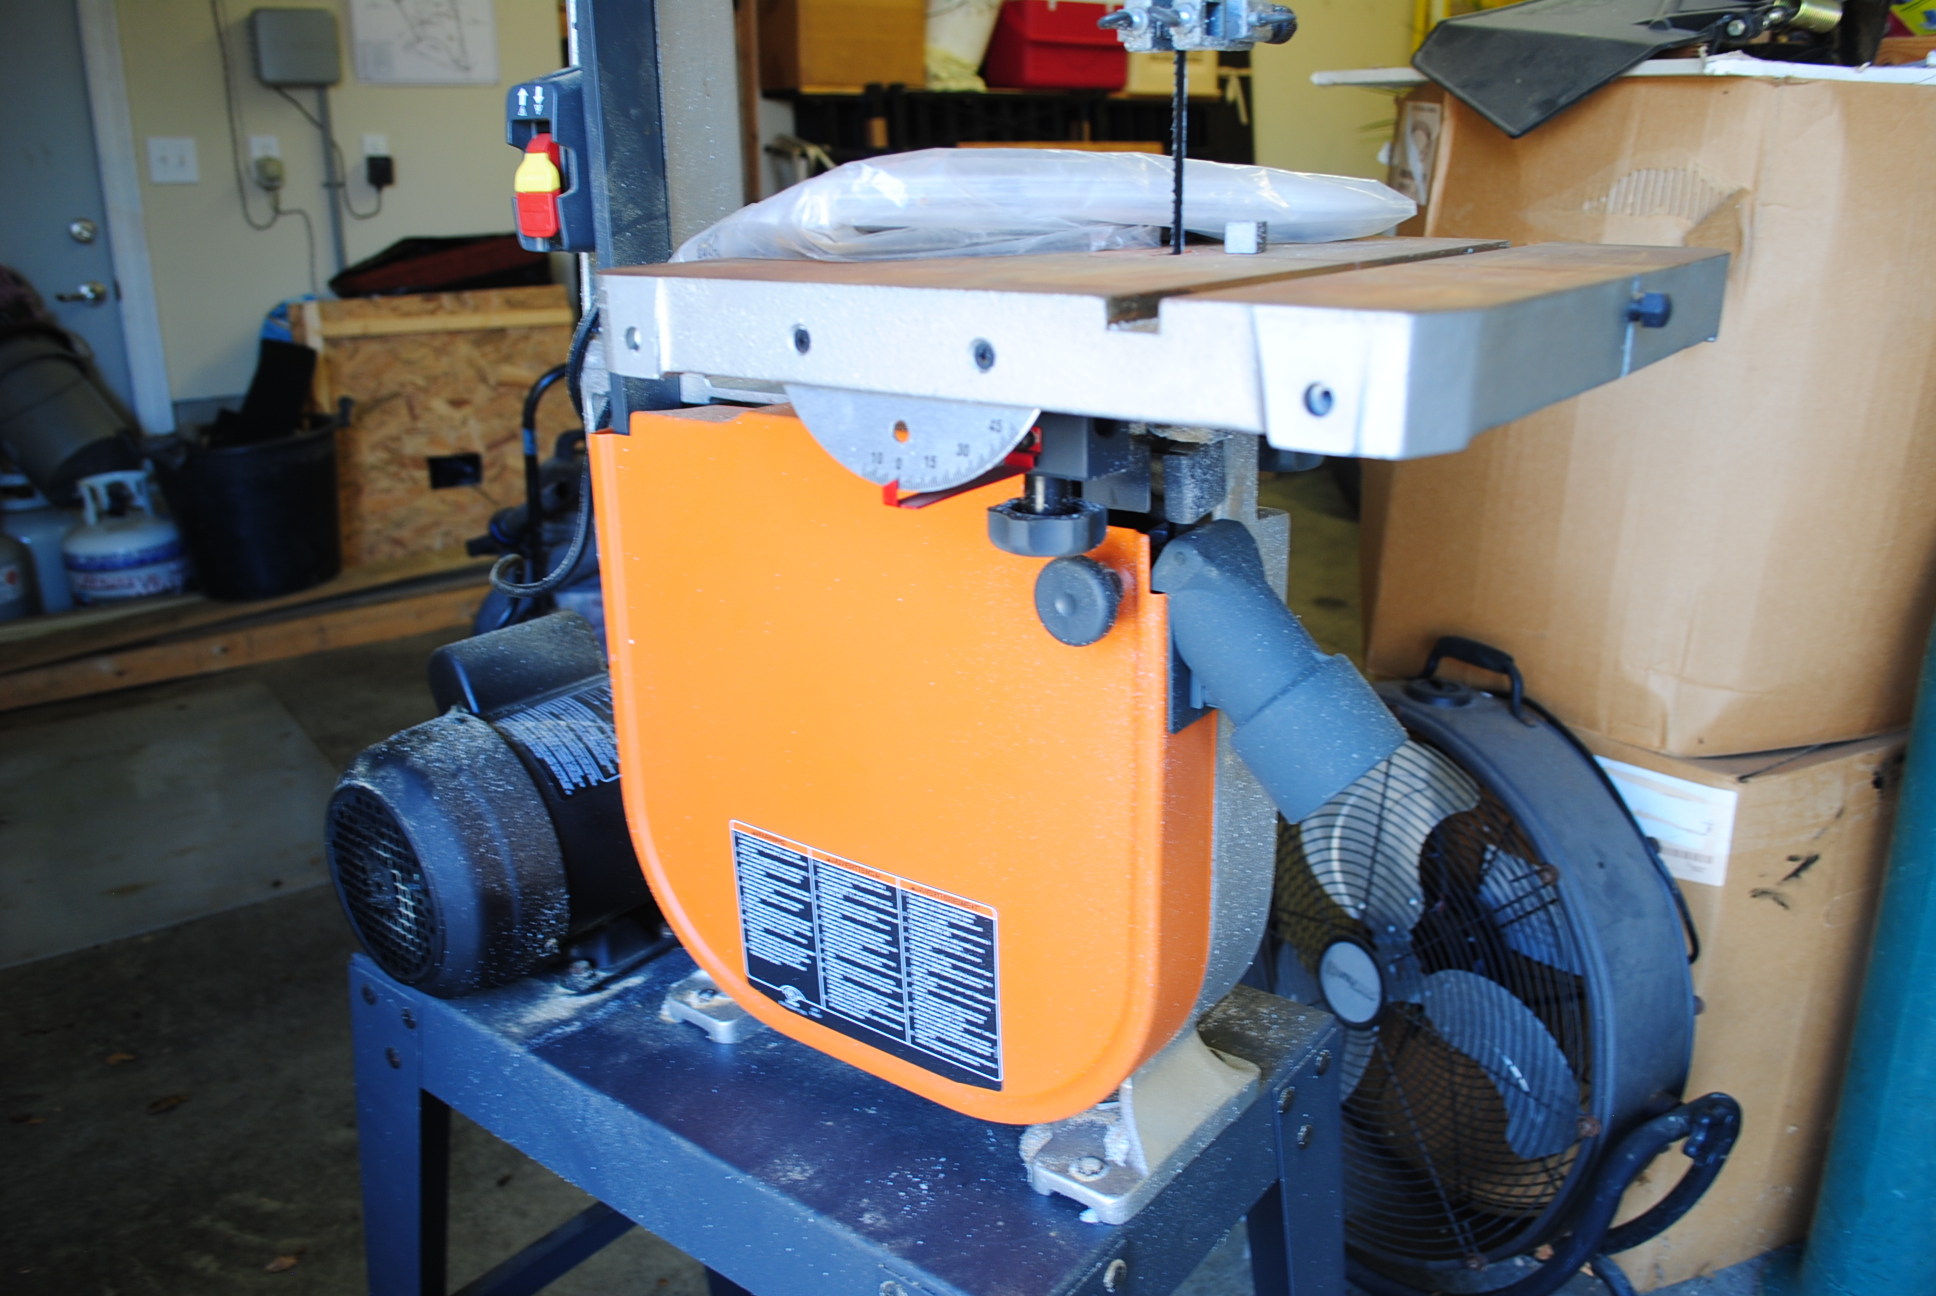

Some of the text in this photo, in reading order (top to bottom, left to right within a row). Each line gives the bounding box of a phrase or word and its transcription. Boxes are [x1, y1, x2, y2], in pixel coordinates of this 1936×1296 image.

[989, 418, 1002, 433] 45
[956, 442, 970, 457] 30
[924, 455, 937, 469] 15
